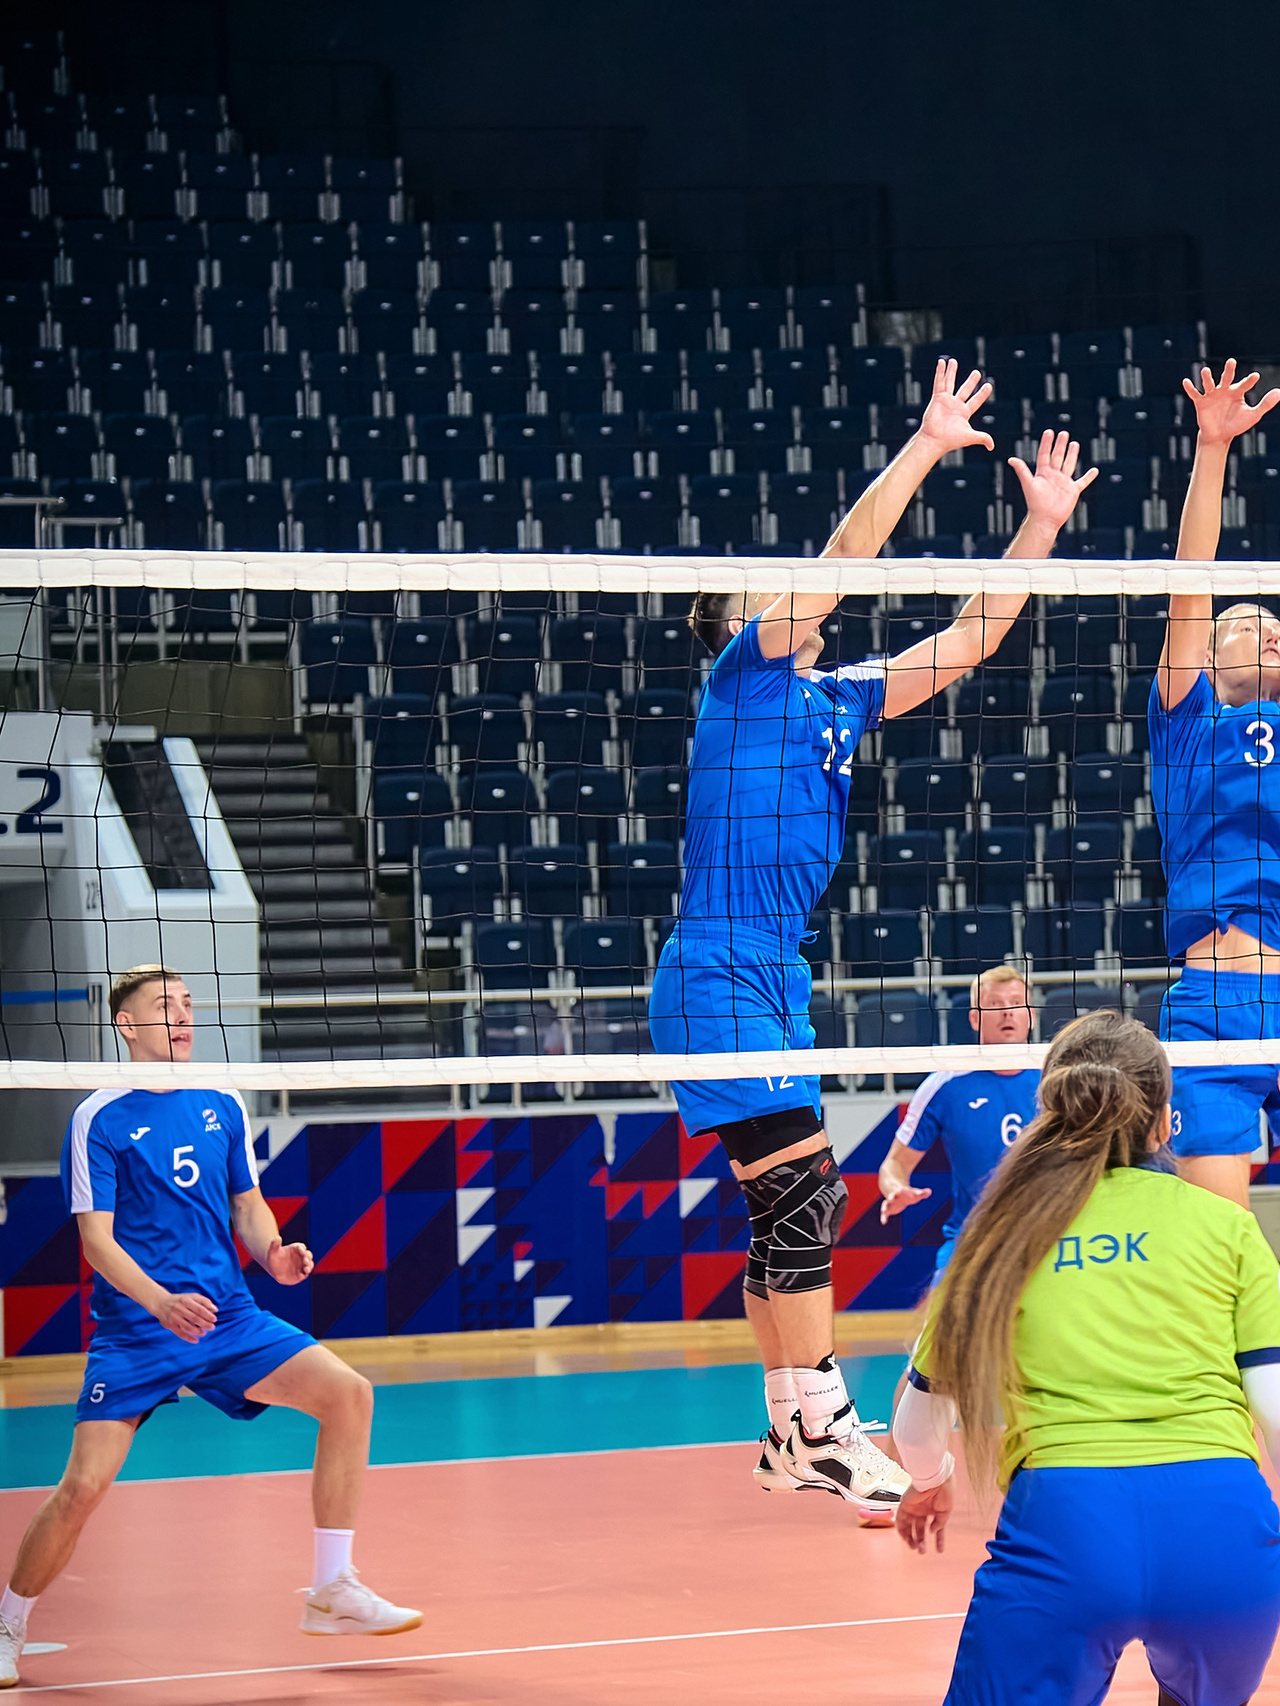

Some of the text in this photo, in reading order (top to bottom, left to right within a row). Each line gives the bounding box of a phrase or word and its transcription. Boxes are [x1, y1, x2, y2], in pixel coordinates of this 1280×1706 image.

[1243, 719, 1275, 768] 3
[1000, 1112, 1023, 1149] 6
[1172, 1110, 1182, 1136] 3
[173, 1144, 201, 1188] 5
[1054, 1232, 1150, 1273] ДЭК
[90, 1383, 106, 1404] 5
[808, 1385, 840, 1396] MUELLER
